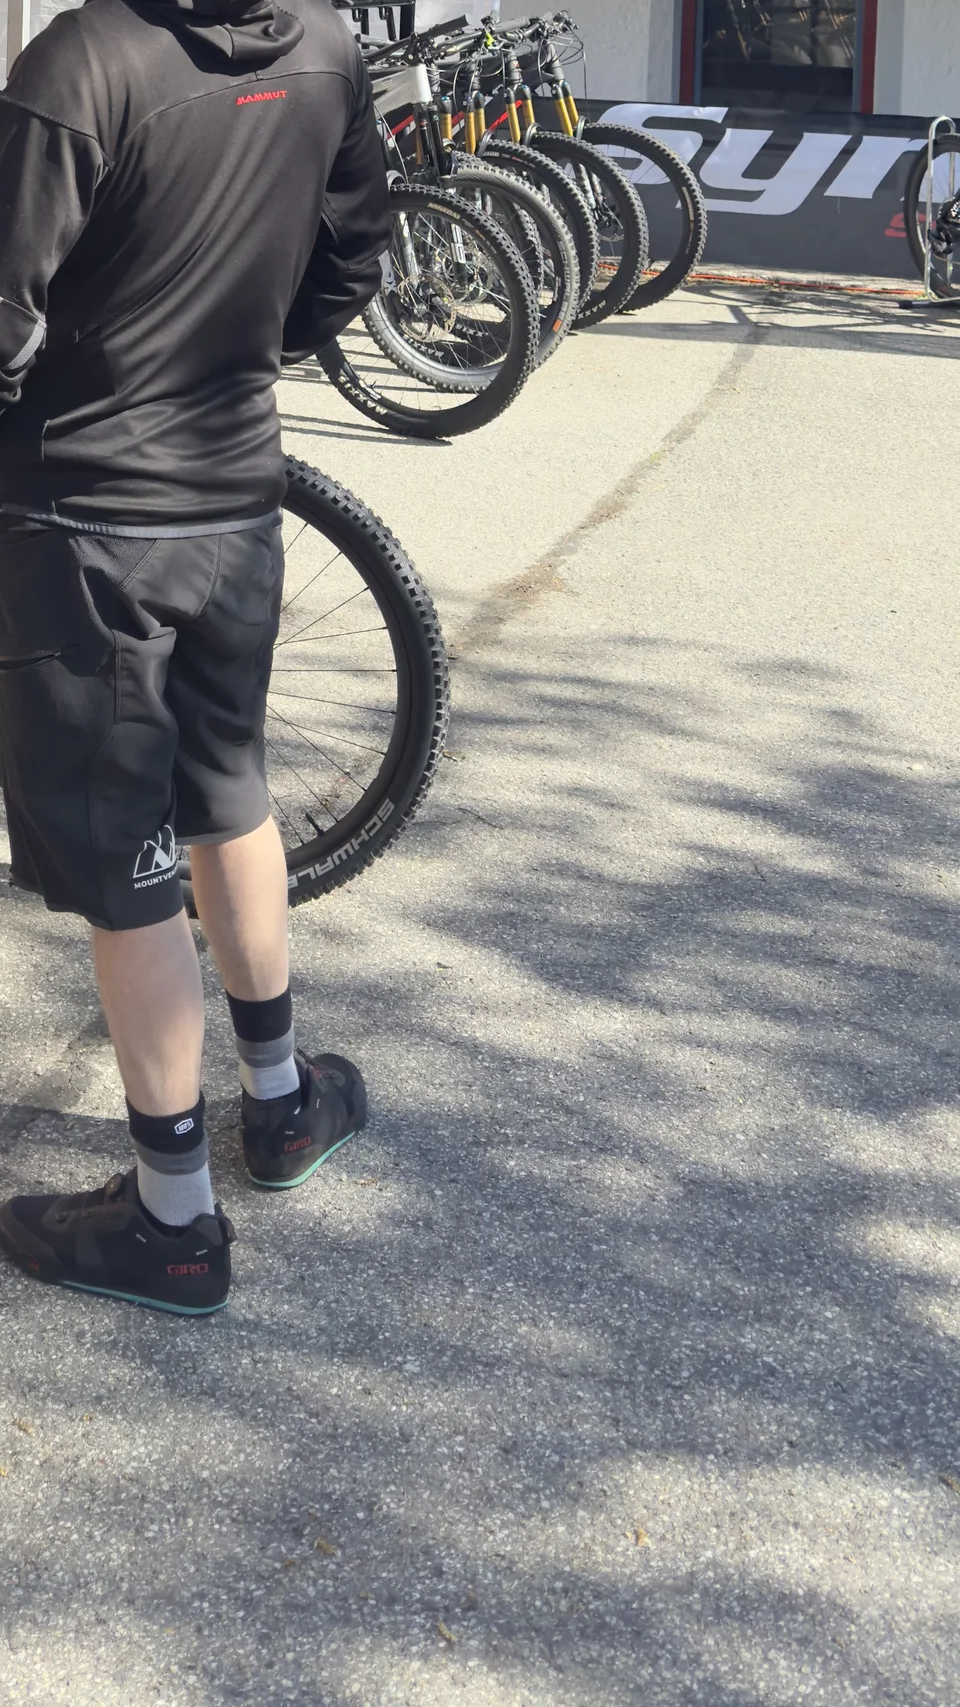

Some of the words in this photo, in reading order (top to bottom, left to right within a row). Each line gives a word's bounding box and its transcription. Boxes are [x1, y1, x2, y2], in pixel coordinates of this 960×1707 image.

[235, 90, 288, 106] MAMMUT
[577, 299, 607, 320] MAXX
[338, 375, 388, 415] MAXXIS
[287, 798, 397, 888] SCHWALB
[167, 1263, 209, 1275] GIRO
